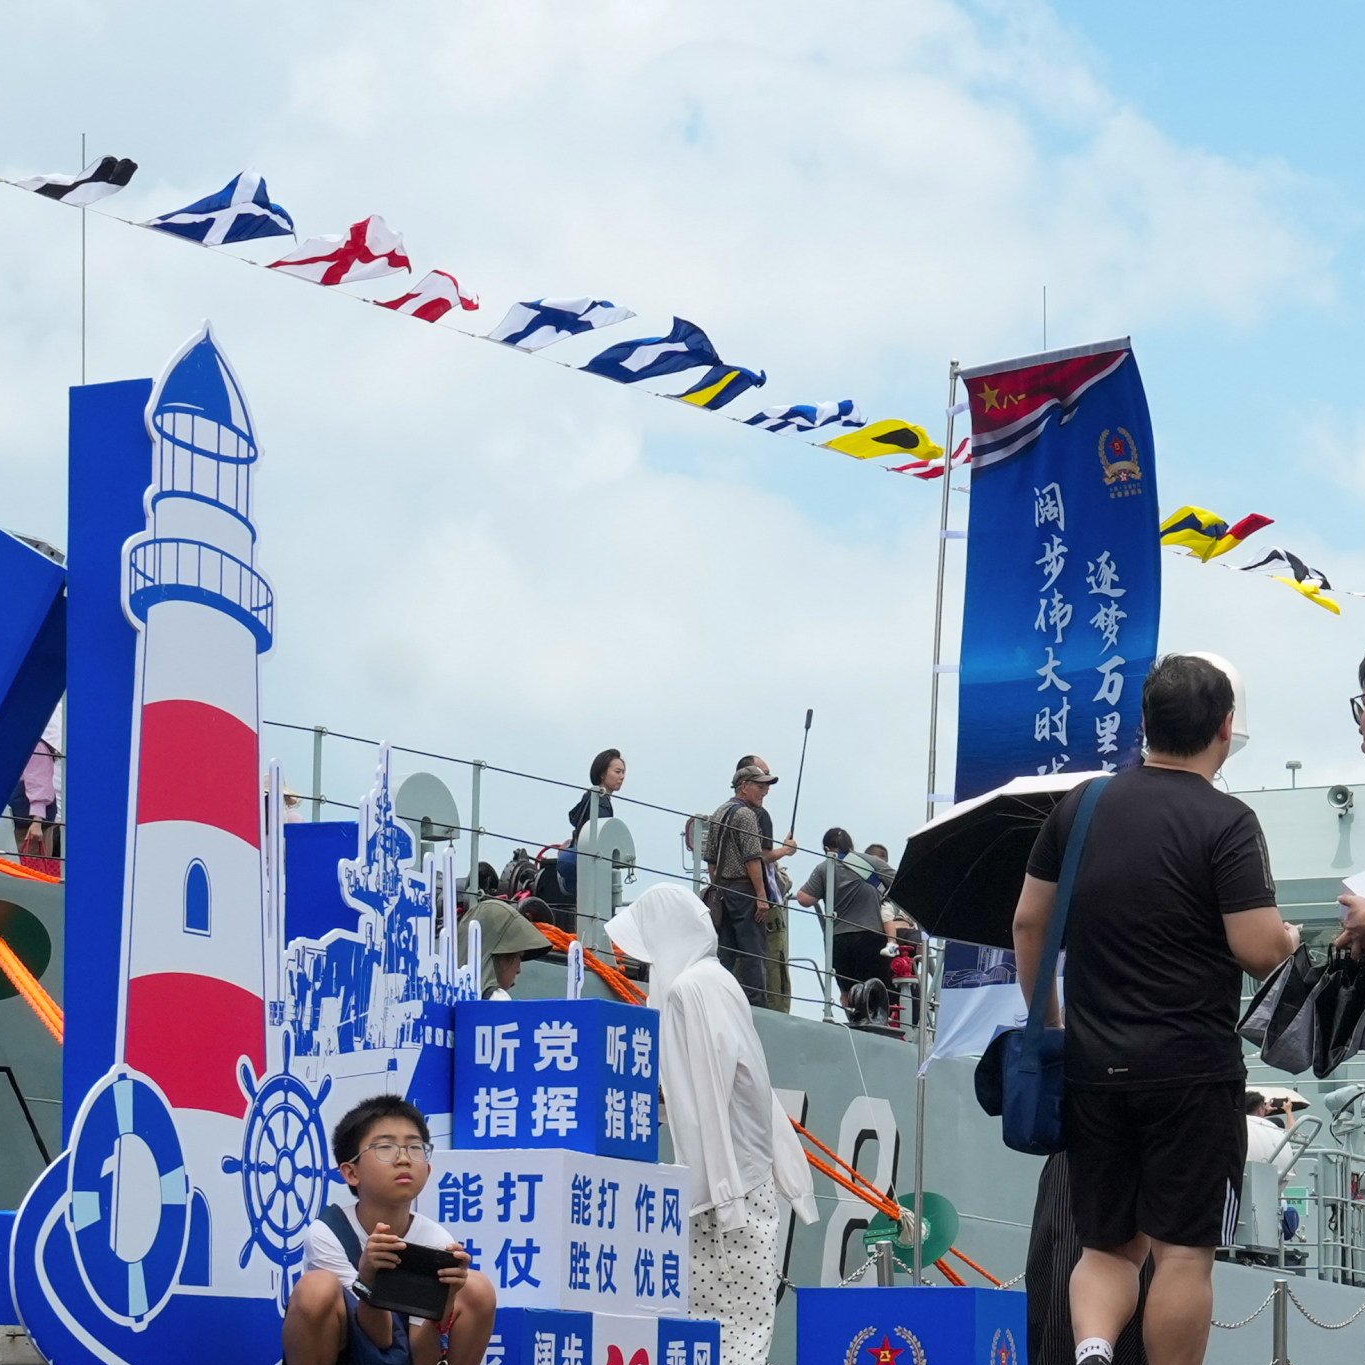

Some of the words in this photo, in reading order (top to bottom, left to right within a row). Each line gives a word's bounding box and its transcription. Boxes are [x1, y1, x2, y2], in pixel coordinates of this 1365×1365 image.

[474, 1020, 579, 1073] 听党
[605, 1025, 652, 1079] 听党
[473, 1086, 579, 1138] 指挥
[604, 1087, 652, 1143] 指挥
[438, 1171, 543, 1223] 能打
[570, 1173, 620, 1230] 能打
[635, 1183, 682, 1237] 作风
[568, 1241, 618, 1295] 胜仗
[634, 1247, 681, 1299] 优良
